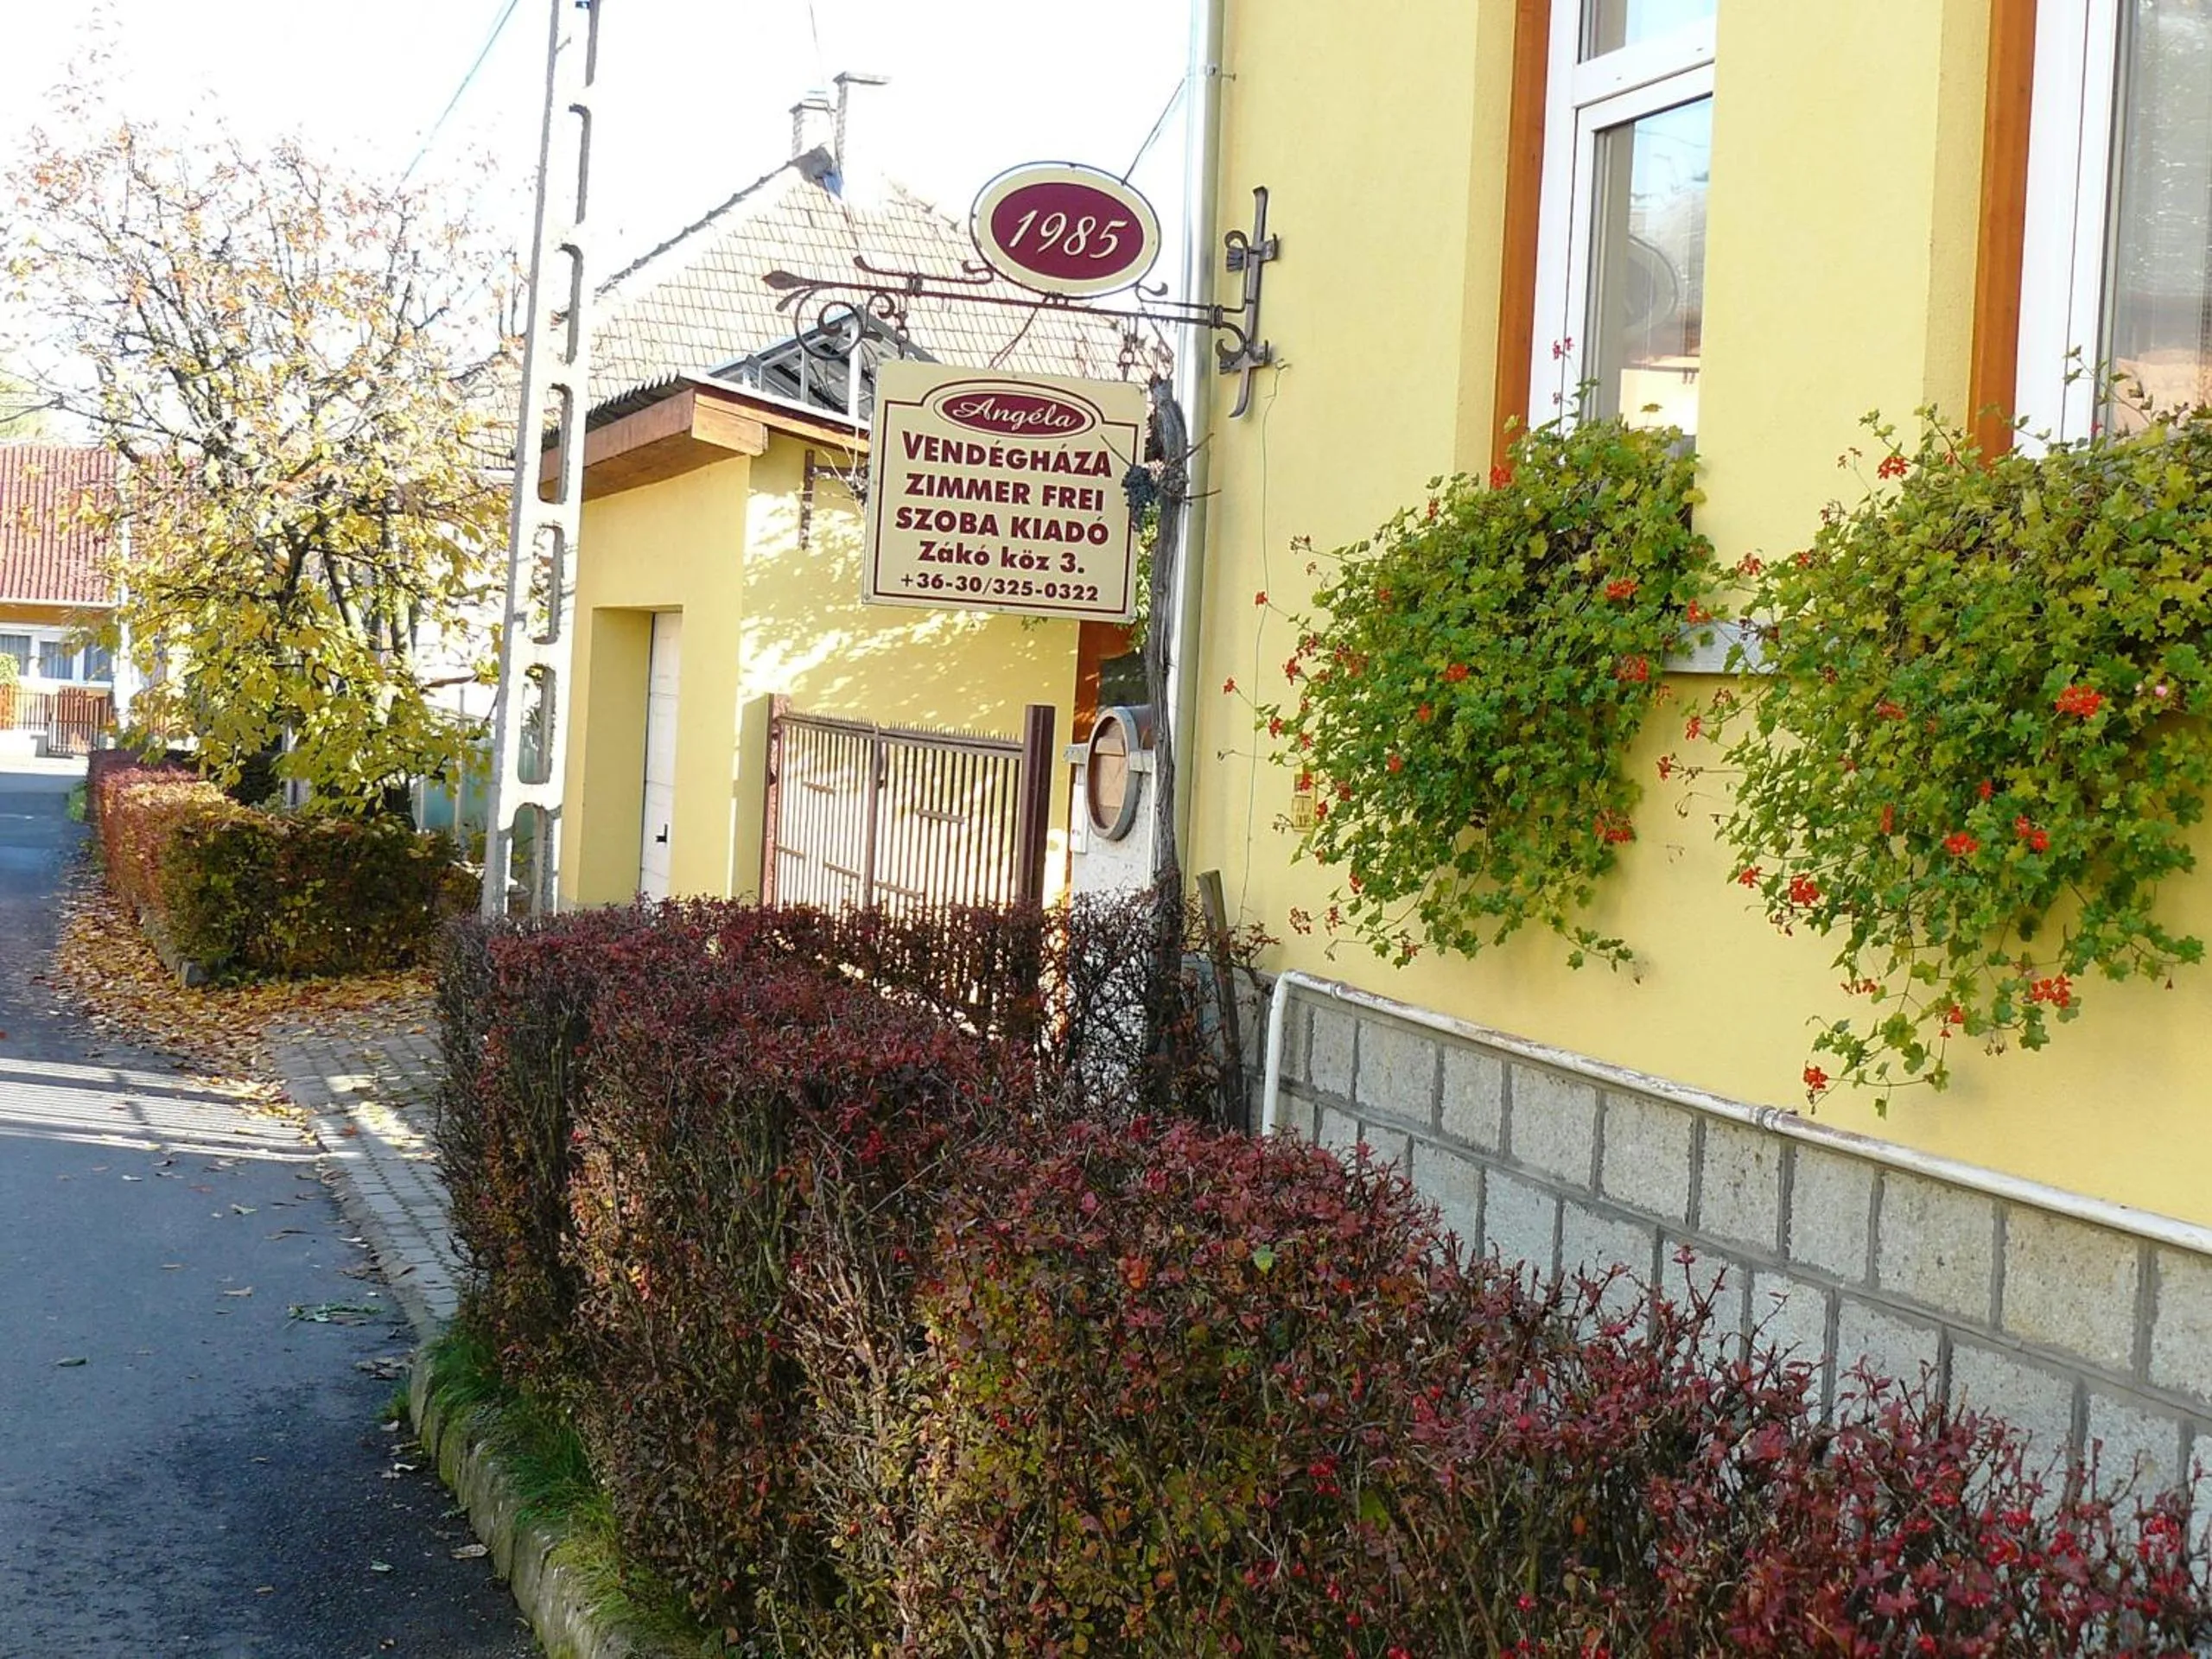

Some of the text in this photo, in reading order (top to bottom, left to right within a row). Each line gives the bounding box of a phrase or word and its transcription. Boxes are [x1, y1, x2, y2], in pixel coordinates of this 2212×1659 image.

[1008, 210, 1128, 259] 1985
[951, 397, 1077, 431] Angéla
[901, 430, 1113, 478] VENDÉGHÁZA
[905, 473, 1104, 512] ZIMMER FREI
[895, 506, 1109, 546] SZOBA KIADÓ
[917, 540, 1085, 575] Zákó köz 3.
[900, 573, 1099, 601] +36-30/325-0322
